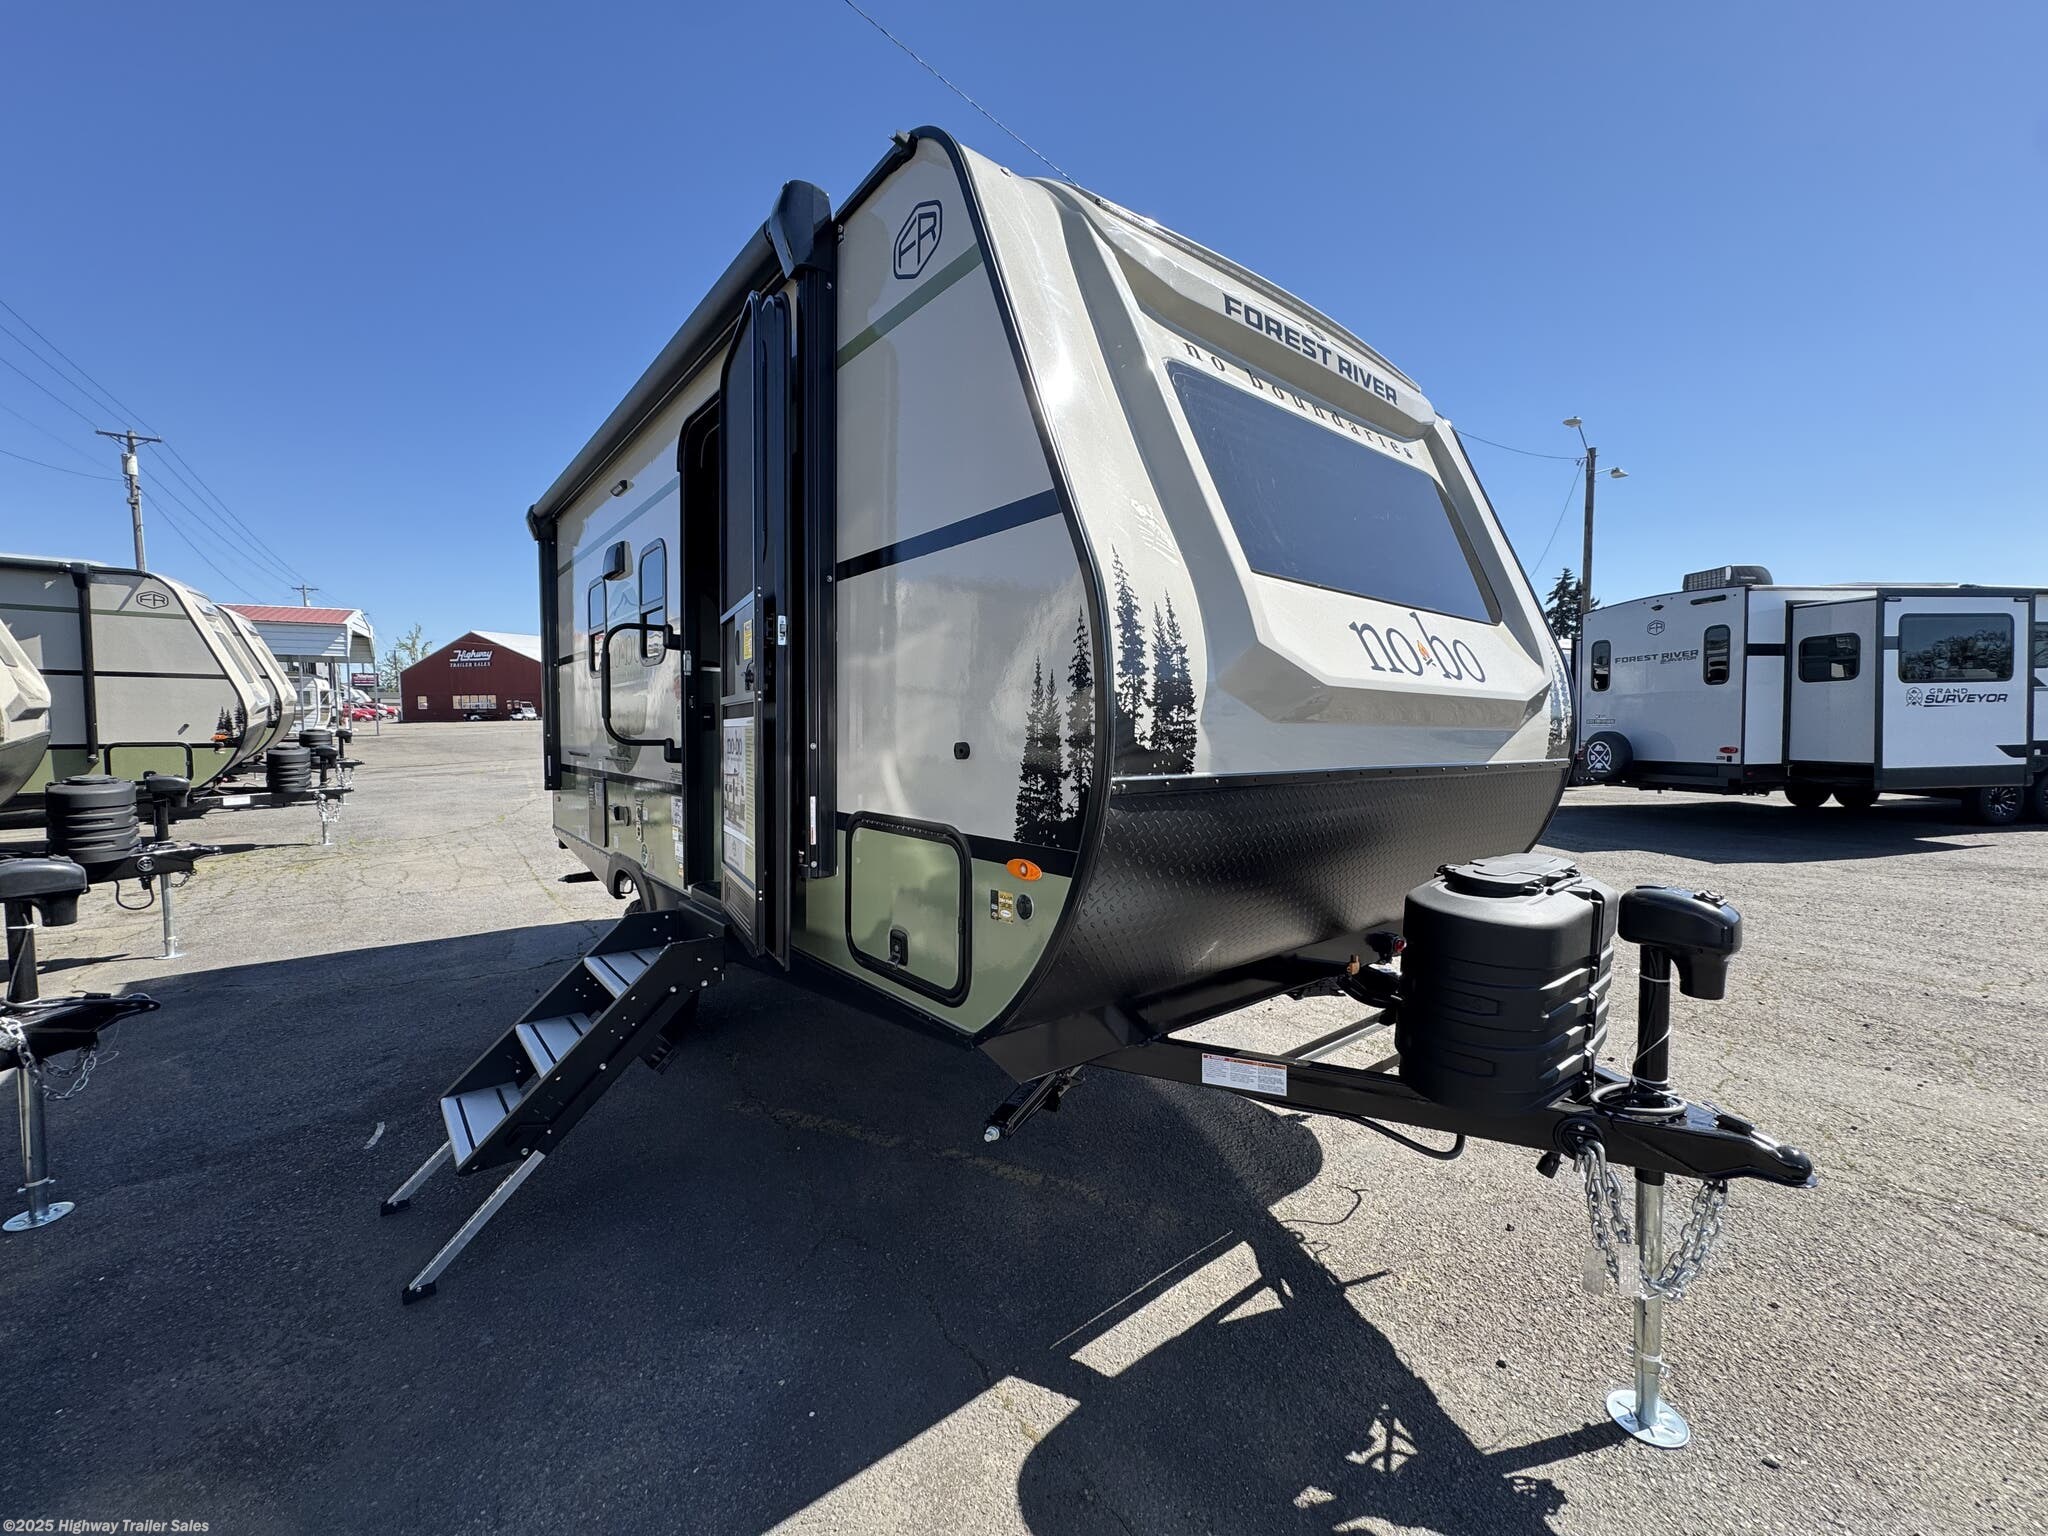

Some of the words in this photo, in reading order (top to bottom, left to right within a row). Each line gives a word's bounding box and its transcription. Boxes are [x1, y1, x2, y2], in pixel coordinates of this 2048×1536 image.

[1222, 292, 1332, 366] FOREST
[1337, 354, 1398, 406] RIVER
[1183, 341, 1226, 372] no
[1245, 367, 1414, 460] boundaries
[449, 649, 493, 662] Highway
[1614, 653, 1659, 664] FOREST
[1661, 649, 1699, 660] RIVER
[1924, 693, 2008, 704] SURVEYOR
